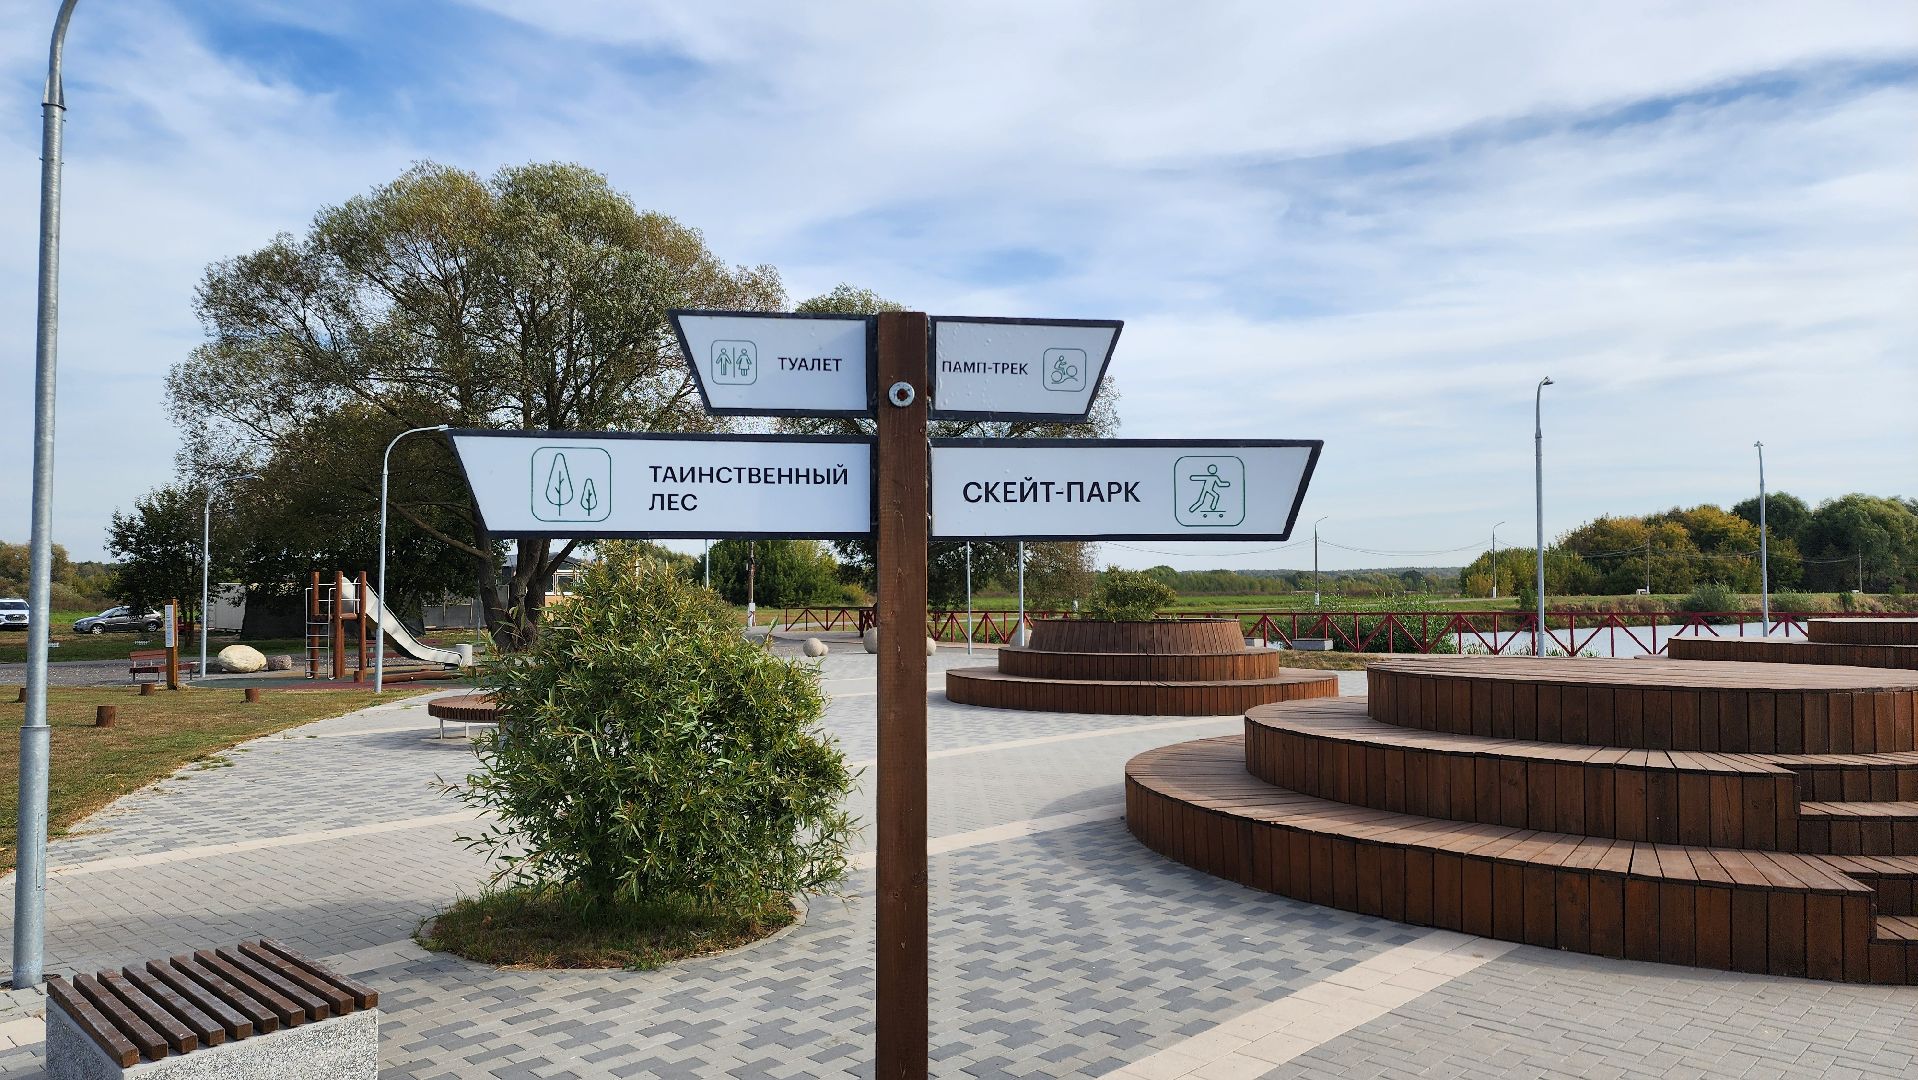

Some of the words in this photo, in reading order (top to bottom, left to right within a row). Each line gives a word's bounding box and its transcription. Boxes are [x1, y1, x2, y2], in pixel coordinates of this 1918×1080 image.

[778, 357, 843, 372] ТУАЛЕТ
[941, 361, 1029, 376] ПАМП-ТРЕК
[649, 464, 848, 486] ТАИНСТВЕННЫЙ
[962, 477, 1142, 504] СКЕЙТ-ПАРК
[649, 493, 697, 511] ЛЕС
